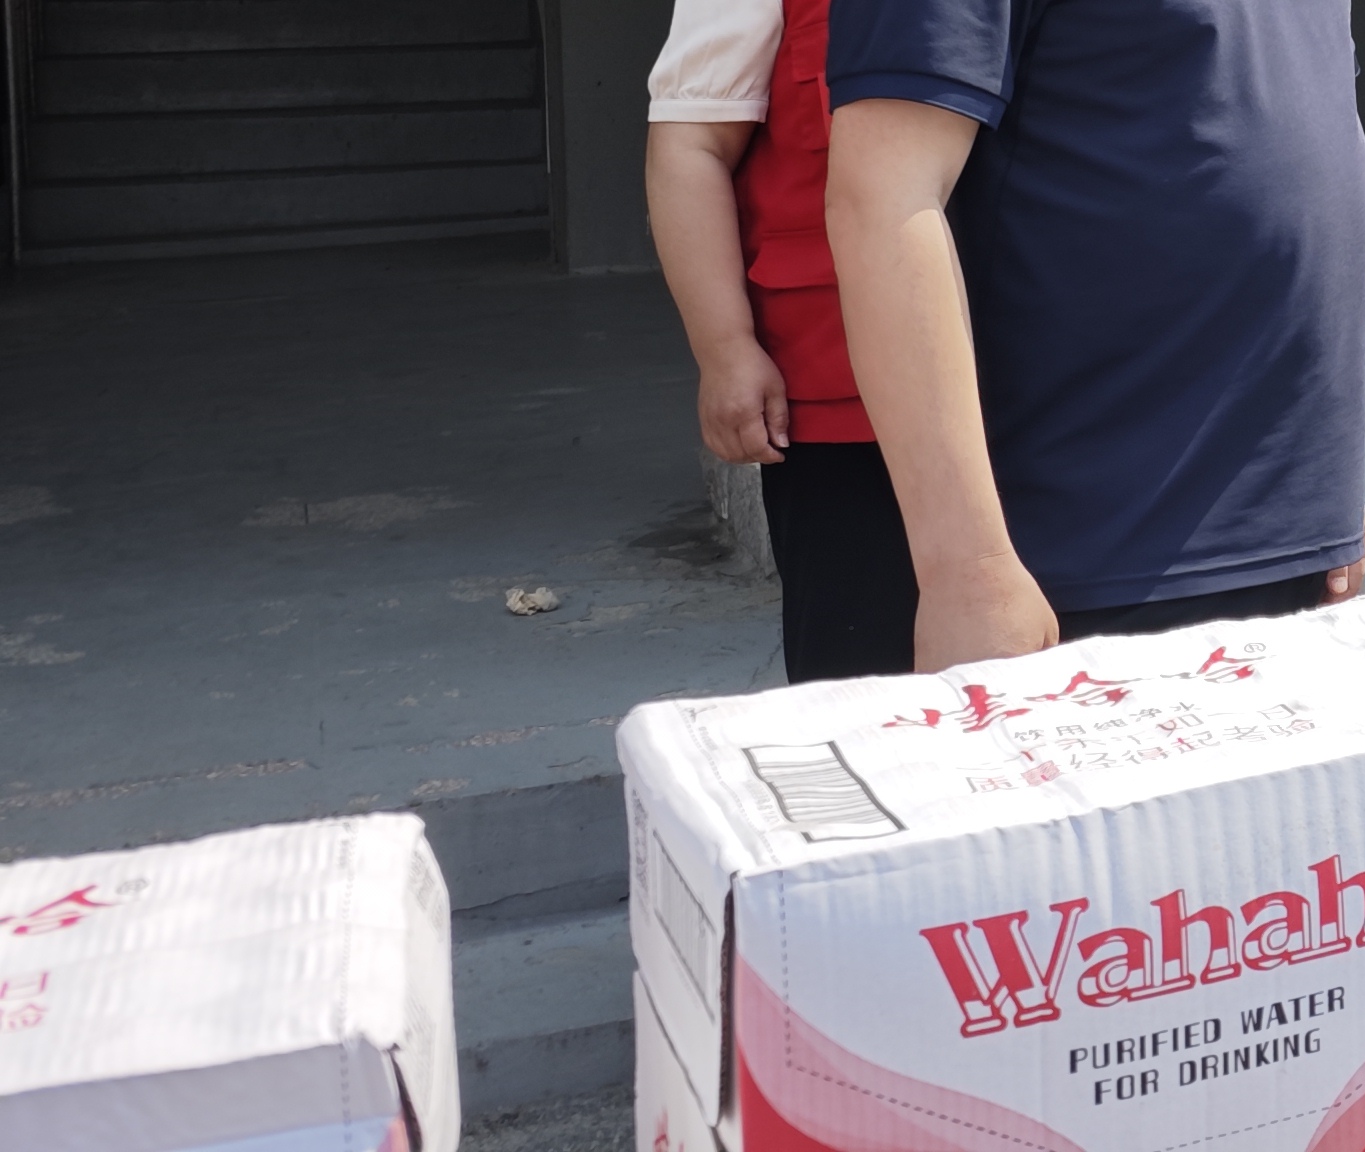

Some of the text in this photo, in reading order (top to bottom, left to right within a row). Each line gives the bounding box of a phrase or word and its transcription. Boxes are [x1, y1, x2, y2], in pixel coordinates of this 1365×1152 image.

[1014, 702, 1202, 742] 饮用纯净水
[1069, 986, 1345, 1074] PURIFIED WATER
[1094, 1028, 1321, 1106] FOR DRINKING
